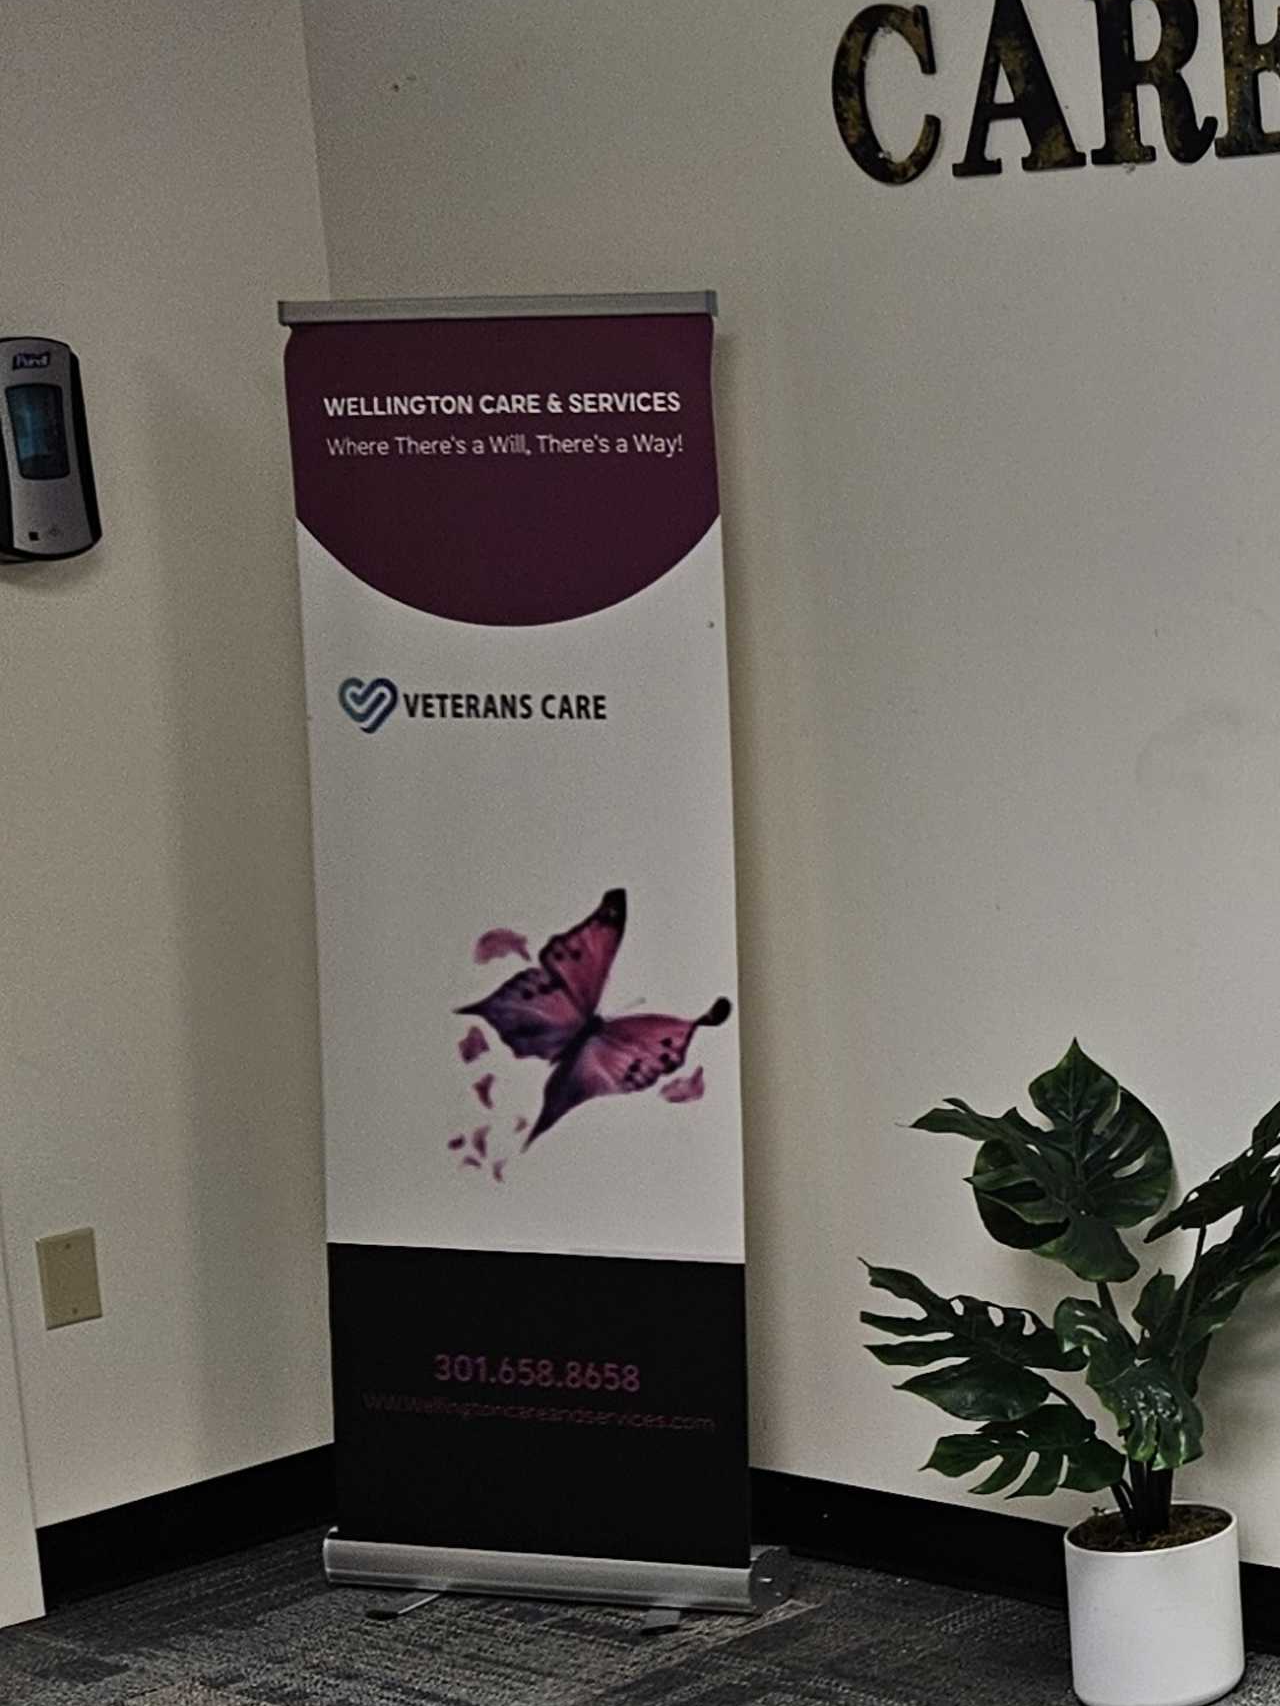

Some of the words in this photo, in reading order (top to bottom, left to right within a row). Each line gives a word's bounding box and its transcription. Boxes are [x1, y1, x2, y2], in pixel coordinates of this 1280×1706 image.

[323, 395, 474, 417] WELLINGTON
[478, 394, 542, 415] CARE
[546, 393, 564, 414] &
[568, 391, 681, 414] SERVICES
[326, 437, 390, 457] Where
[394, 435, 468, 456] There's
[471, 440, 485, 455] a
[488, 434, 532, 457] Will,
[536, 434, 611, 455] There's
[615, 438, 629, 454] a
[633, 433, 684, 459] Way!
[403, 693, 532, 720] VETERANS
[540, 693, 608, 720] CARE
[433, 1353, 642, 1393] 301.658.8658
